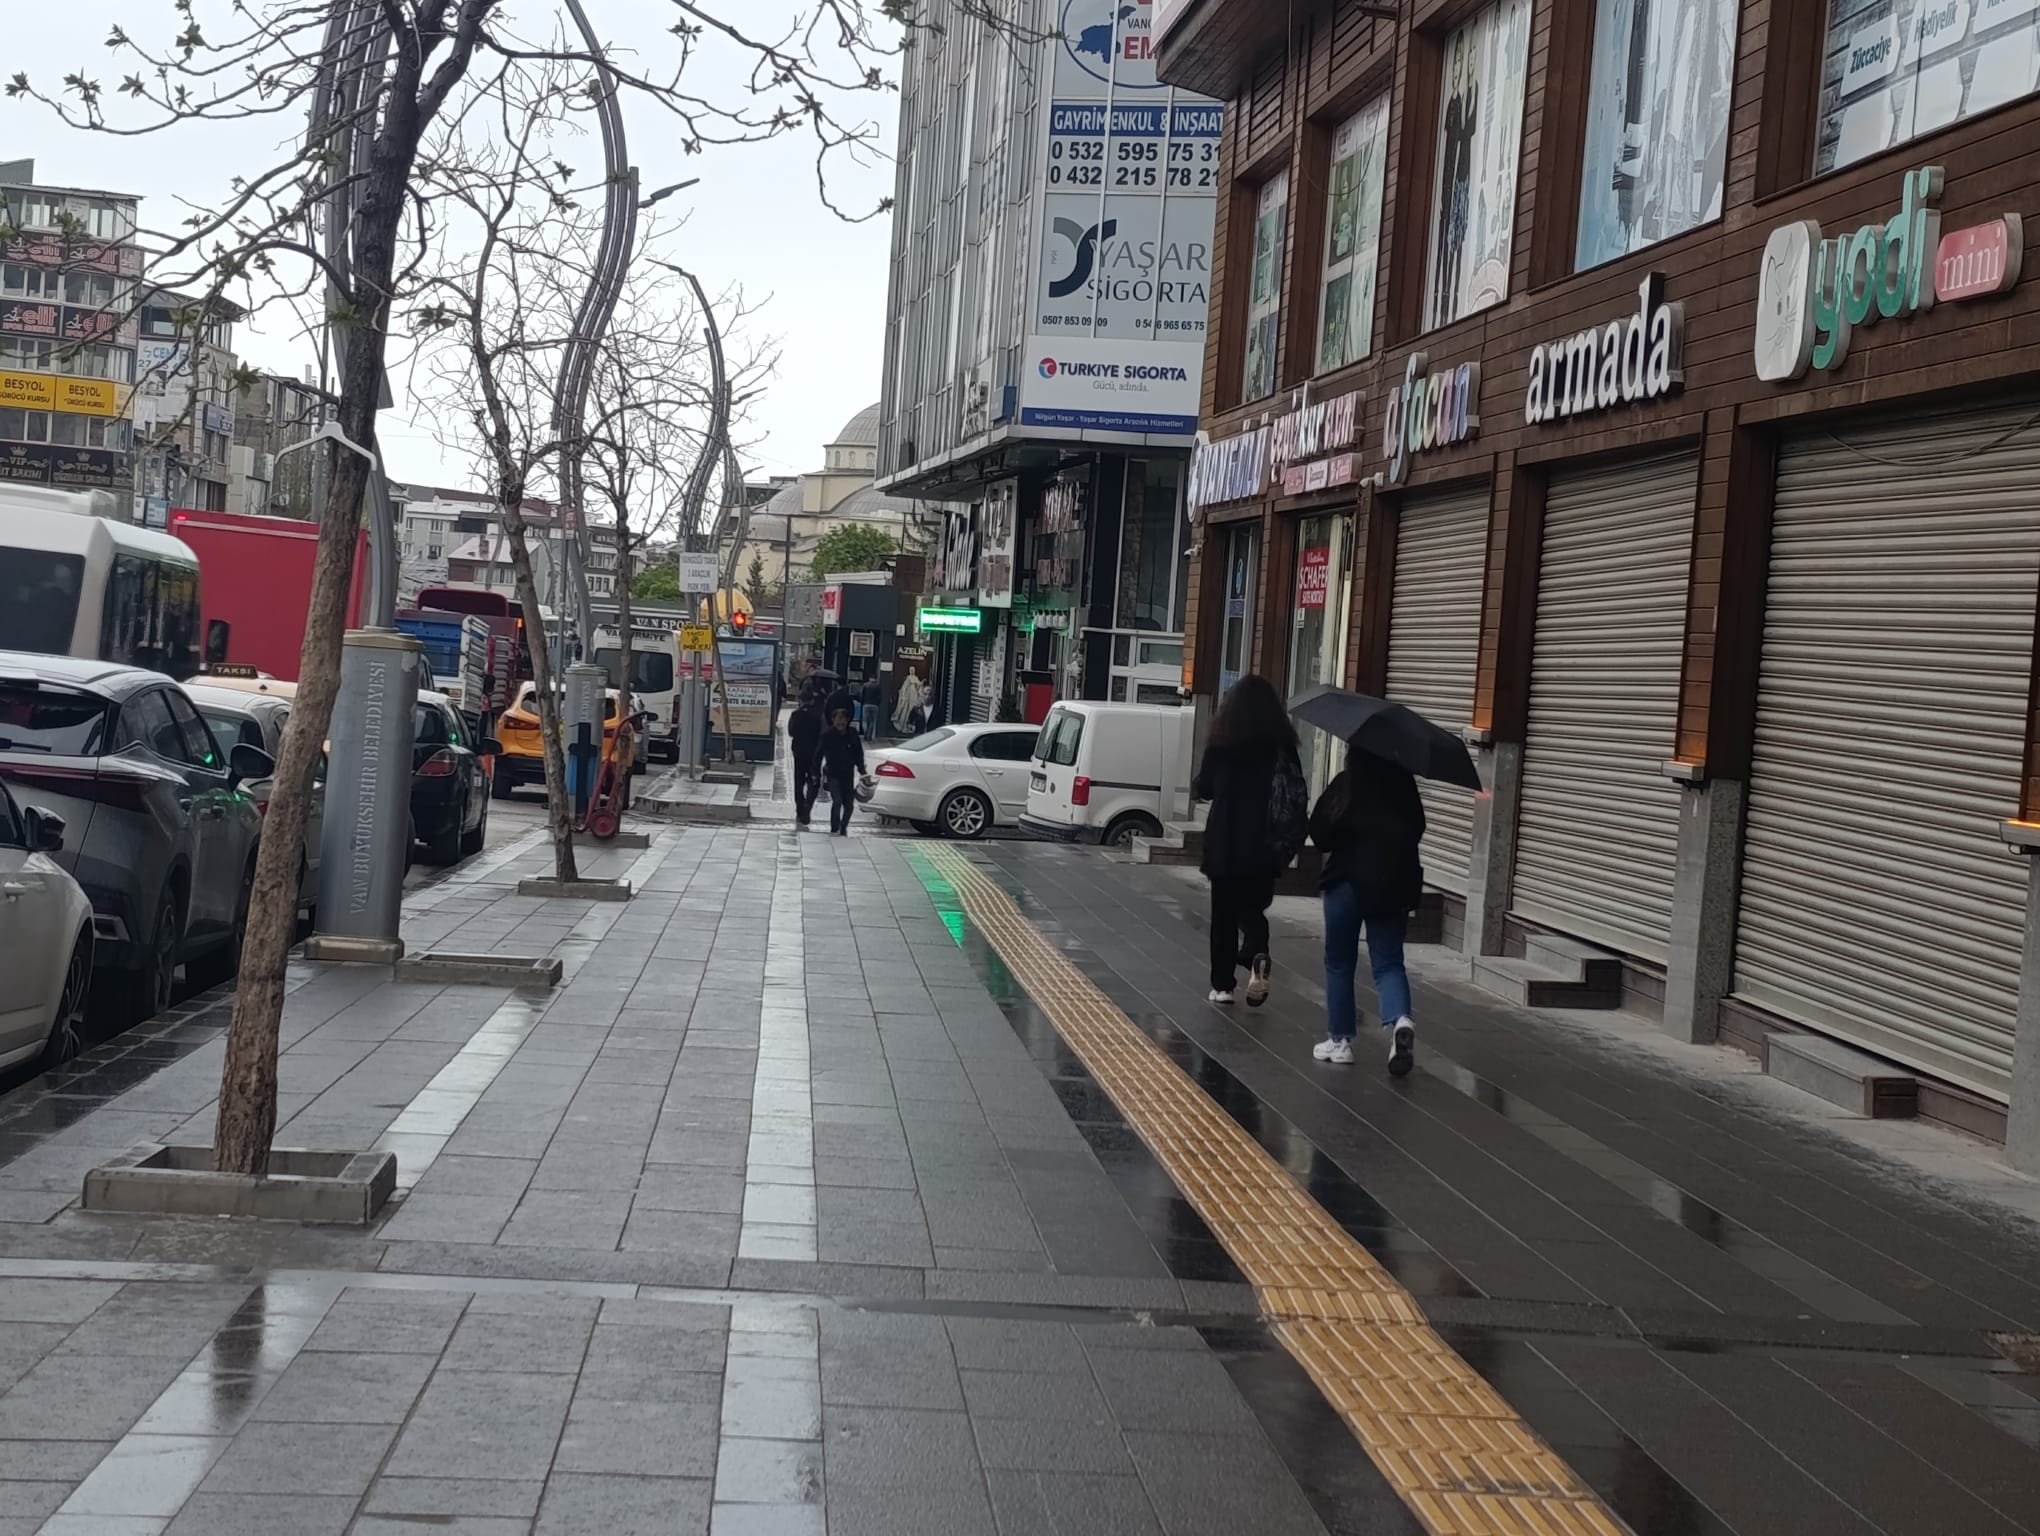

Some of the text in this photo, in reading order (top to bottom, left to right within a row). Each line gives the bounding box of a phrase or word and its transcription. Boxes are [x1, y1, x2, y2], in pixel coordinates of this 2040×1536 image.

[1127, 18, 1152, 29] VAN
[1054, 107, 1154, 131] GAYRİMENKUL
[1069, 141, 1104, 161] 532
[1117, 143, 1158, 162] 595
[1169, 143, 1193, 162] 75
[1067, 166, 1102, 185] 432
[1116, 167, 1156, 186] 215
[1168, 168, 1192, 186] 78
[1090, 239, 1208, 277] YAŞAR
[1812, 166, 2001, 369] yodi mini
[1086, 275, 1207, 304] SİGORTA
[1525, 272, 1673, 426] armada
[1383, 352, 1471, 484] afacan
